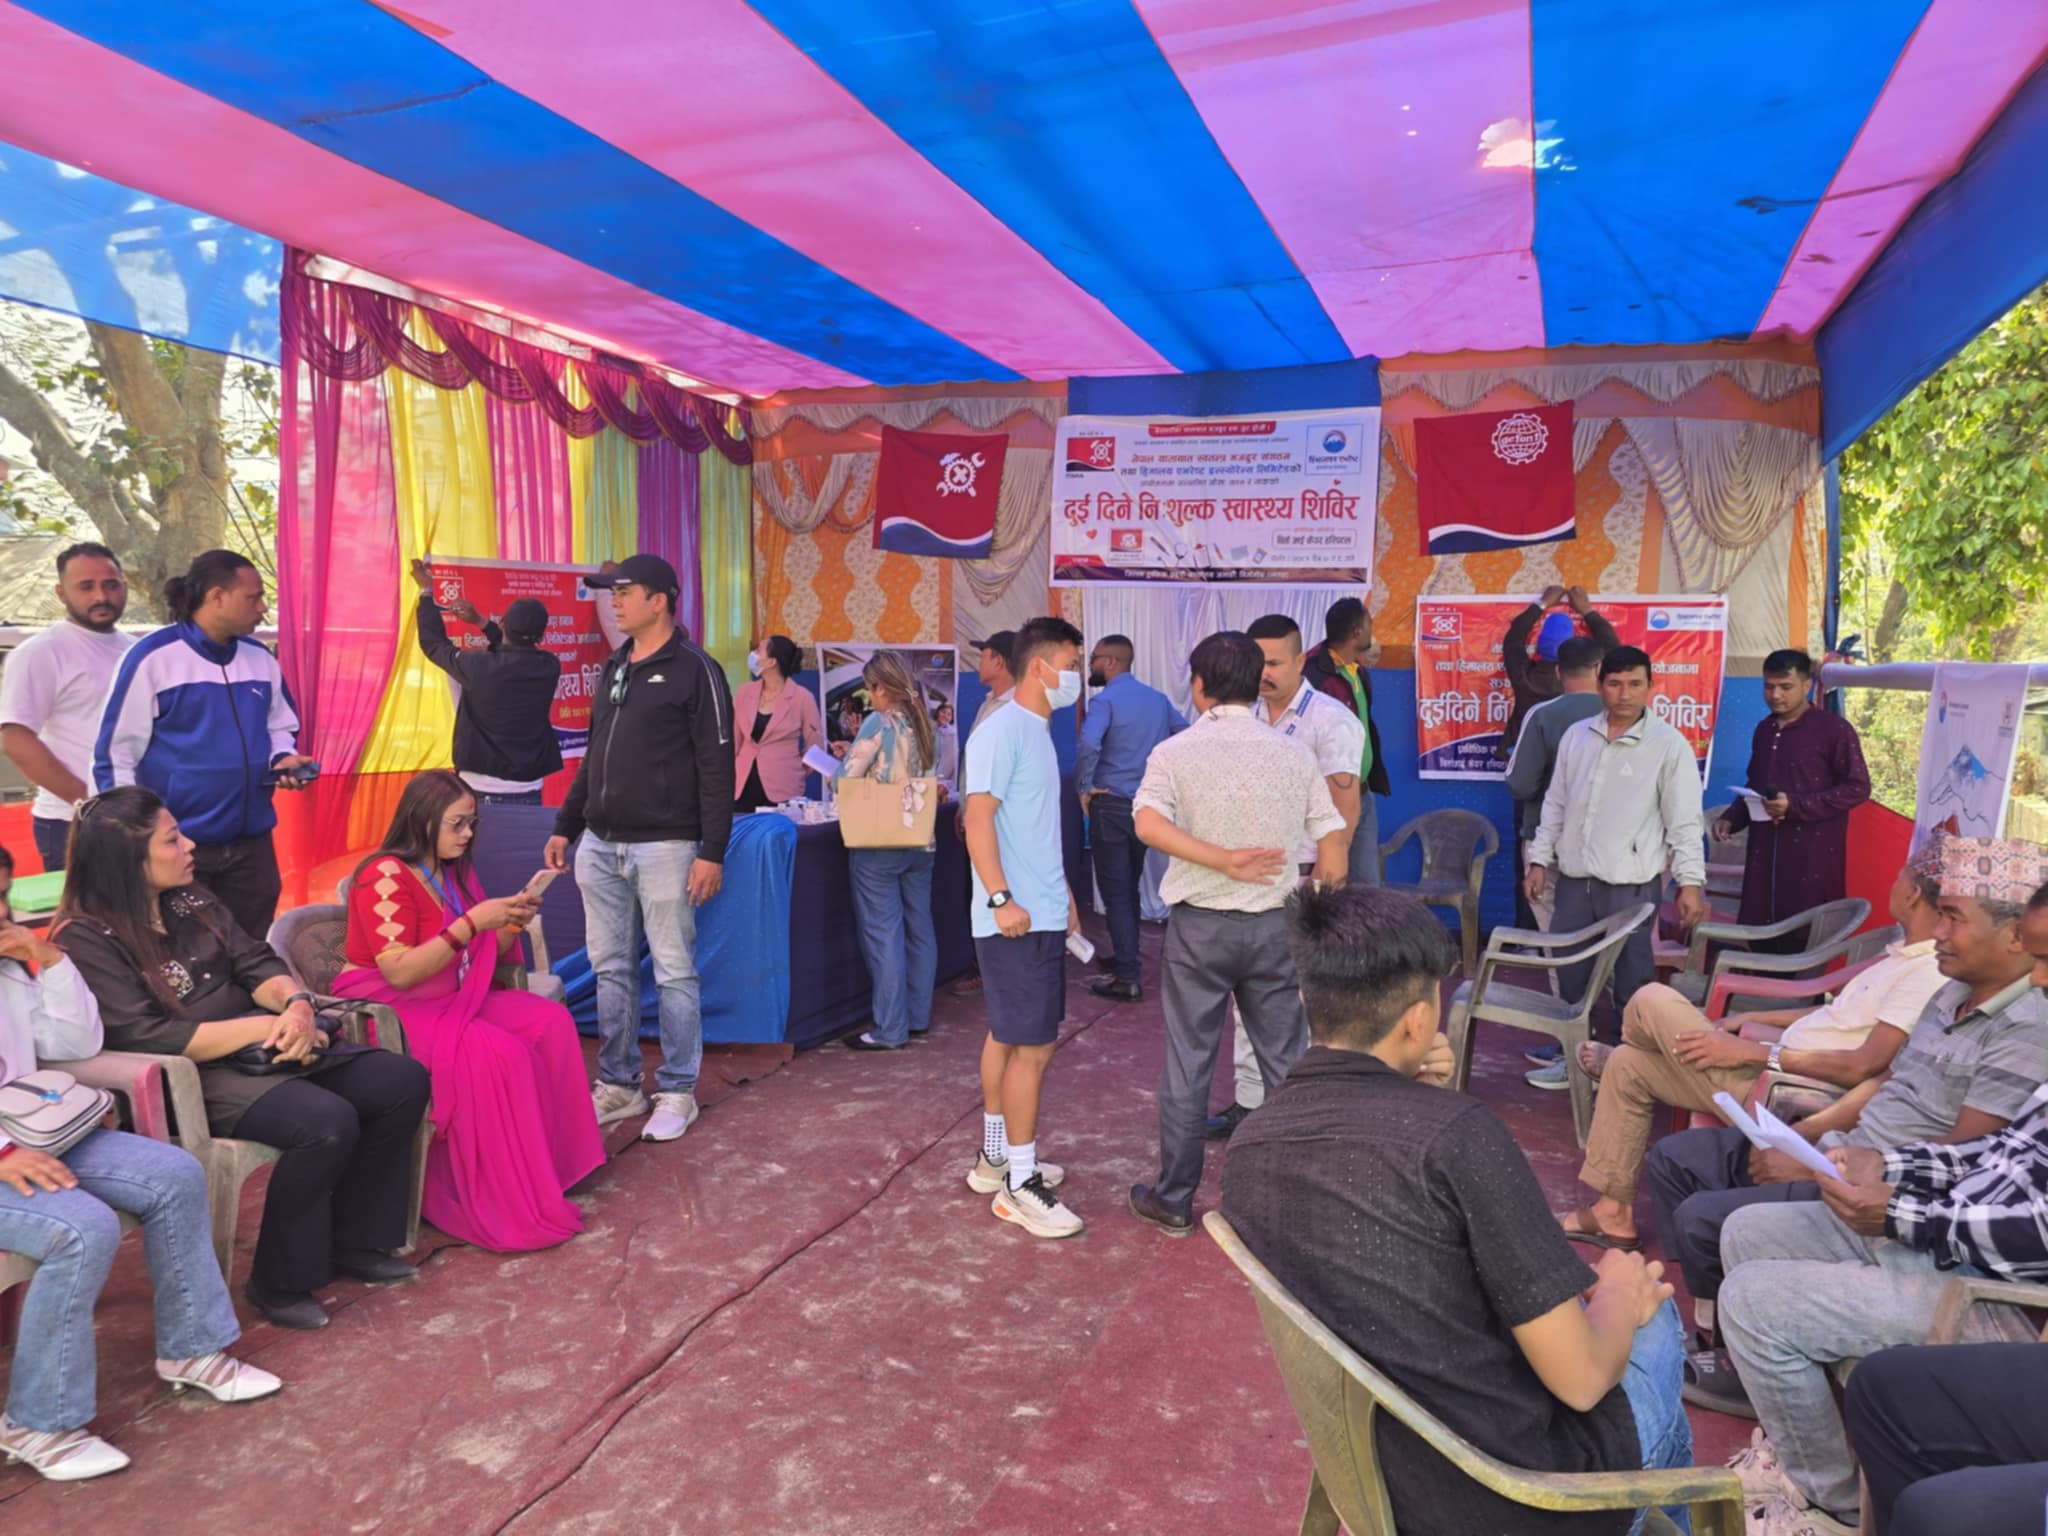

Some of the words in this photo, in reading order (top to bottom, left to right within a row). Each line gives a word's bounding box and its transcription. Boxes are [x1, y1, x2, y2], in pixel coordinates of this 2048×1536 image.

[1064, 493, 1091, 527] दुई
[1097, 491, 1133, 521] दिने
[1222, 498, 1295, 521] स्वास्थ्य
[1301, 488, 1361, 521] शिविर
